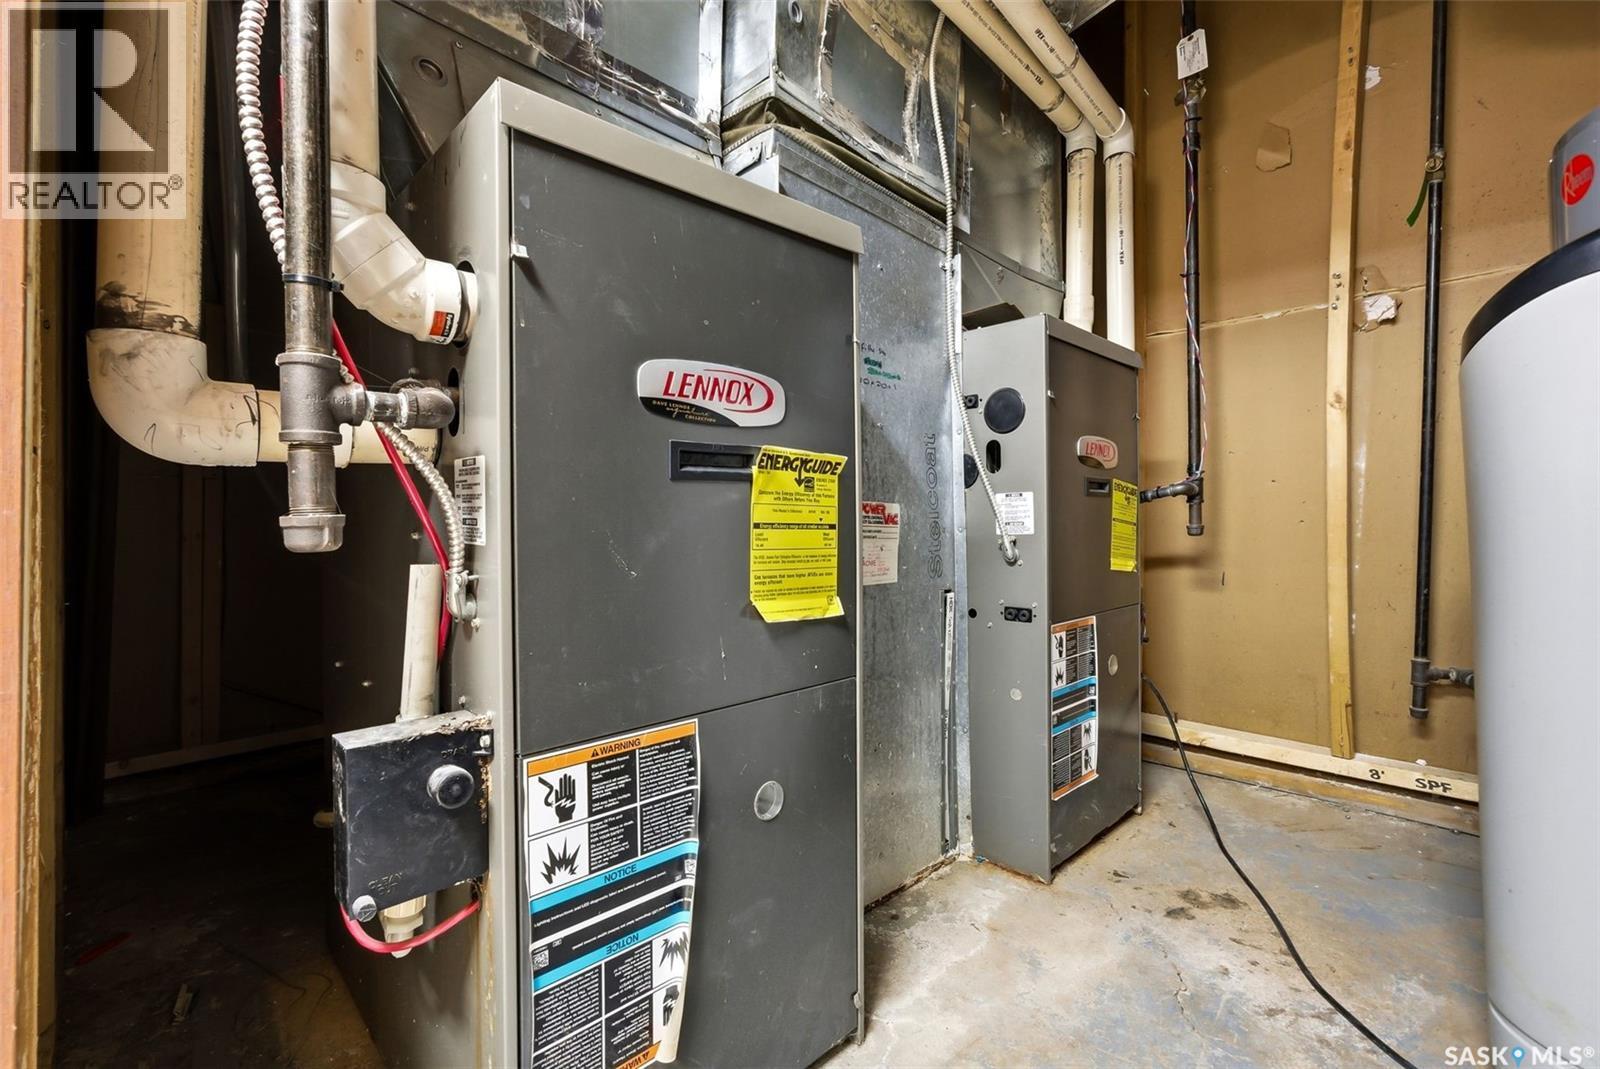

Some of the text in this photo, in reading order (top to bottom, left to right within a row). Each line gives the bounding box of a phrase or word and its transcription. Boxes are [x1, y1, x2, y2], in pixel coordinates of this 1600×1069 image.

[663, 371, 756, 406] LENNOX
[757, 453, 842, 477] ENERGYGUIDE
[600, 738, 641, 756] WARNING
[1414, 778, 1453, 794] SPF
[603, 863, 637, 883] NOTICE
[605, 932, 640, 955] NOTICE
